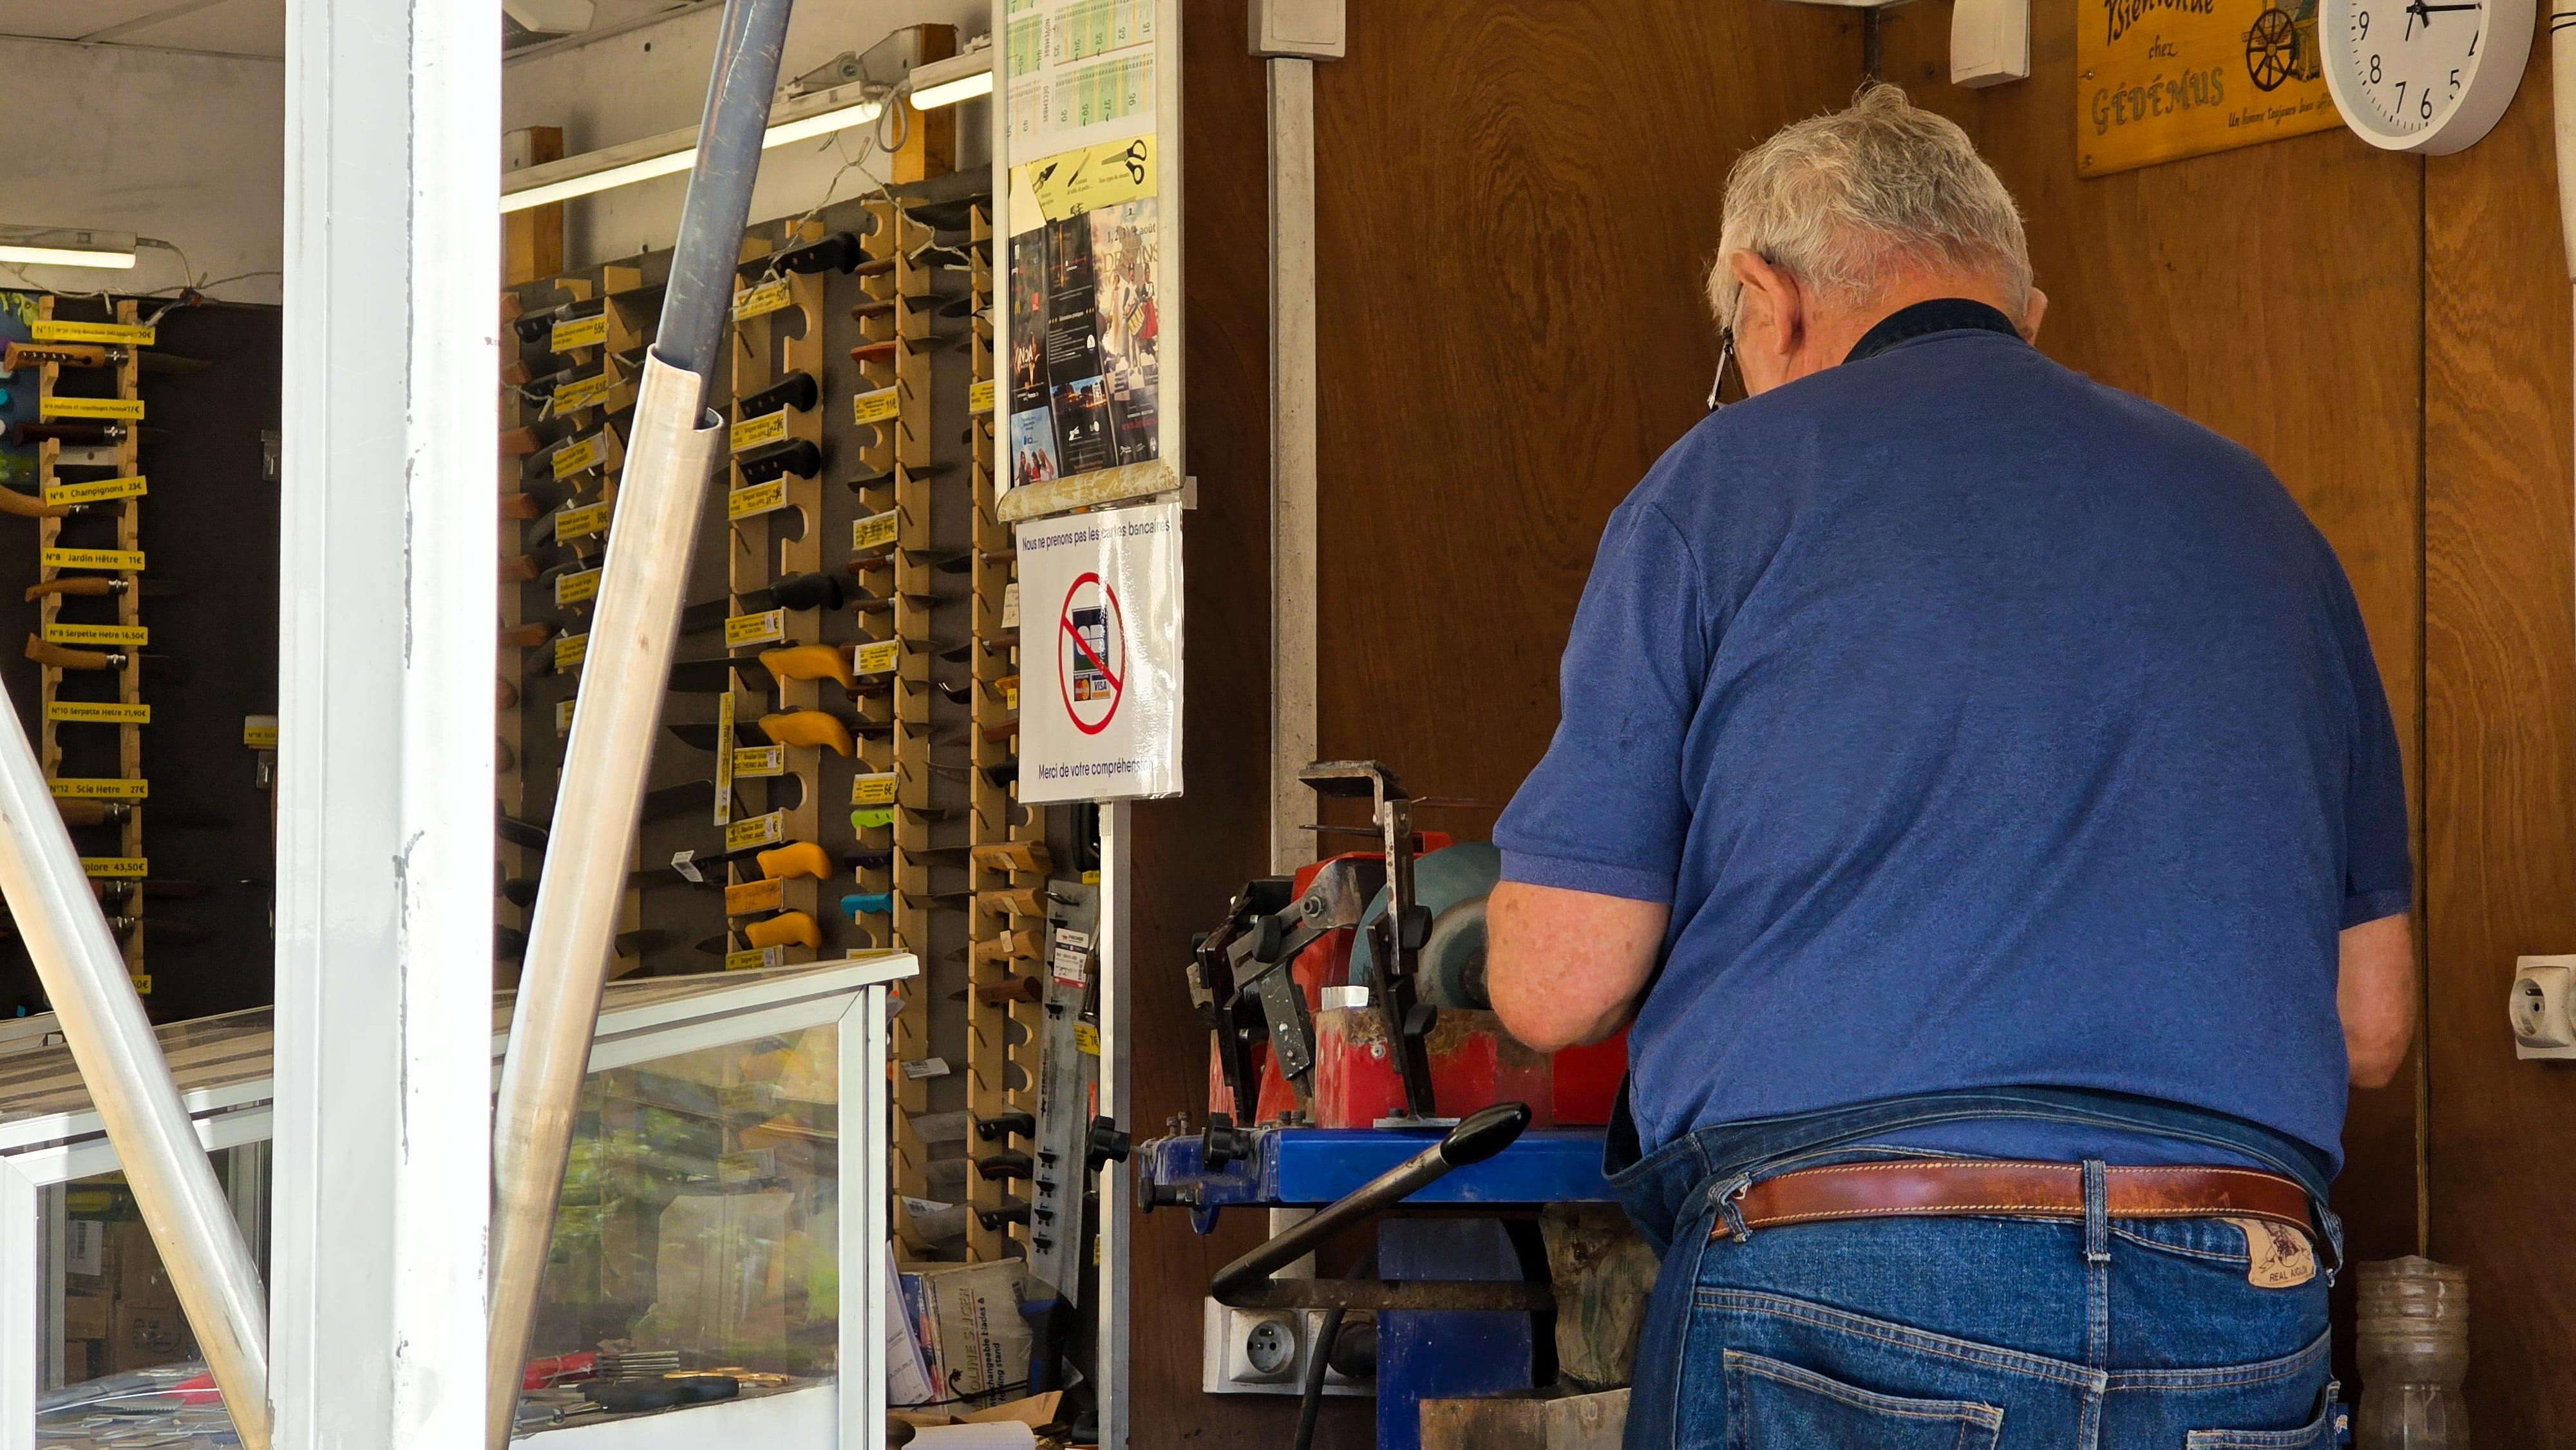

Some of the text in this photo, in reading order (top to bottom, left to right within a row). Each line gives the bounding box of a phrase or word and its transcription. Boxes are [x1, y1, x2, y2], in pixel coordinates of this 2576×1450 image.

[2359, 11, 2369, 41] 9
[2148, 35, 2179, 59] chez
[2370, 54, 2382, 84] 8
[2092, 67, 2224, 136] GÉDÉMUS
[2395, 81, 2407, 113] 7
[2421, 88, 2432, 119] 6
[2228, 112, 2239, 127] Un
[2268, 105, 2297, 126] toujours
[1139, 223, 1156, 235] août
[71, 485, 124, 498] Champignons
[129, 482, 142, 491] 23€
[1023, 537, 1037, 551] Nous
[1037, 538, 1045, 549] ne
[1046, 532, 1072, 551] prenons
[1074, 529, 1086, 547] pas
[1088, 526, 1100, 541] les
[1128, 519, 1170, 536] bancaires
[68, 554, 93, 562] Jardin
[95, 554, 118, 563] Hêtre
[66, 629, 97, 638] Serpette
[122, 632, 144, 641] 16,50€
[1094, 681, 1107, 691] VISA
[70, 708, 100, 716] Serpette
[1039, 762, 1057, 780] Merci
[1059, 762, 1069, 777] de
[1071, 762, 1089, 777] votre
[76, 785, 93, 793] Scie
[96, 785, 120, 793] Hetre
[113, 863, 145, 872] 43,50€
[2269, 1270, 2288, 1282] REAL
[992, 1342, 1003, 1368] stand
